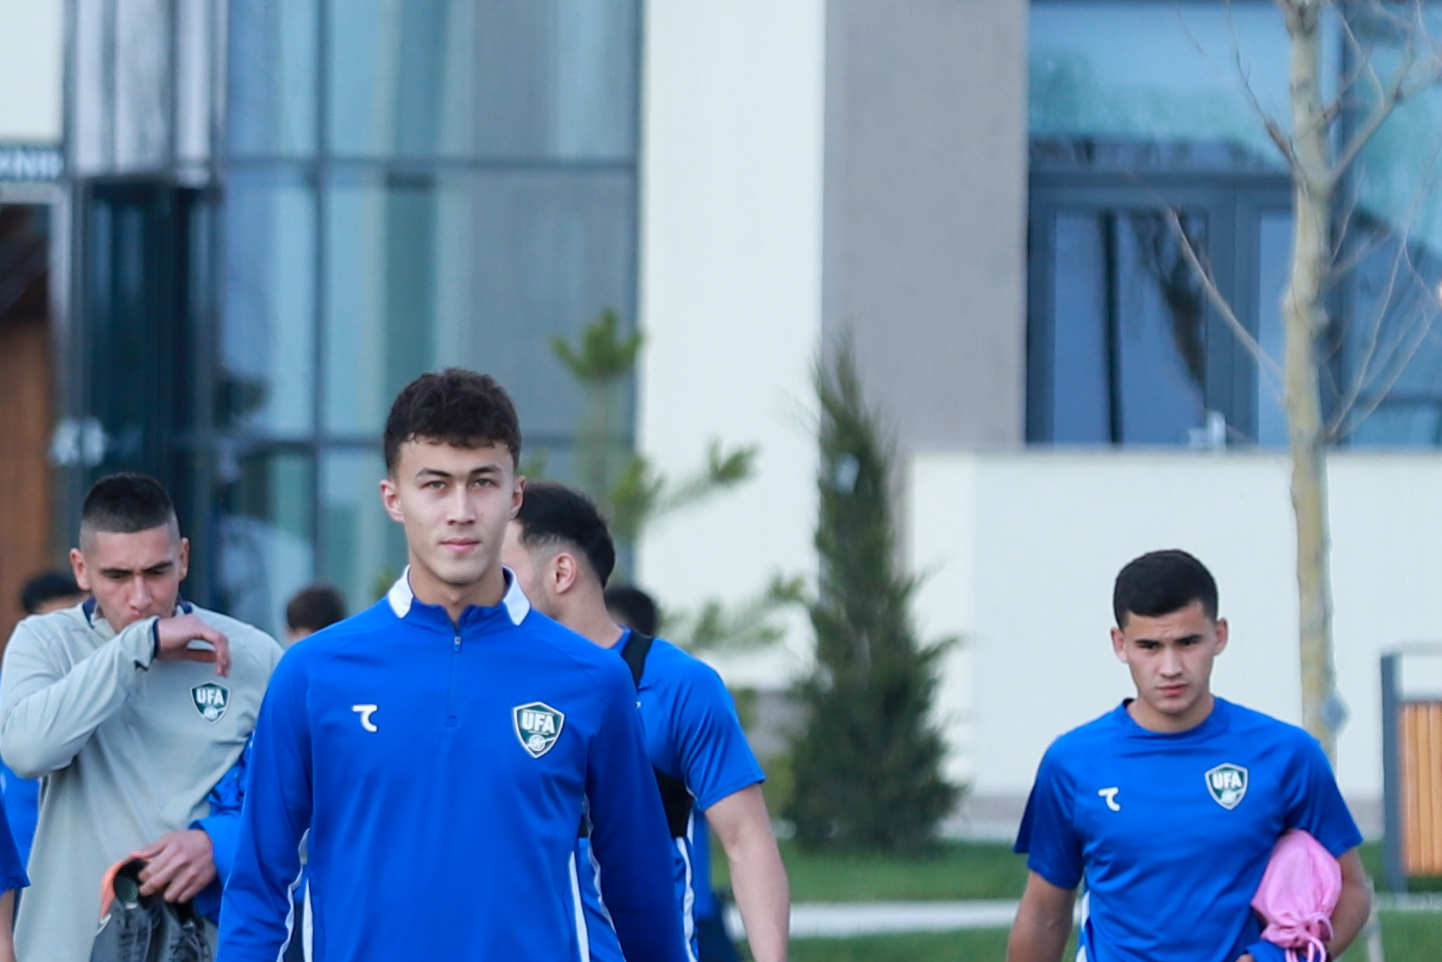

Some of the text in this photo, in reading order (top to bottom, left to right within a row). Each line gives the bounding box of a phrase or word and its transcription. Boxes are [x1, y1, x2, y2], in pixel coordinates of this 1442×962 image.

[196, 687, 225, 706] UFA
[522, 712, 555, 734] UFA
[1212, 771, 1242, 789] UFA
